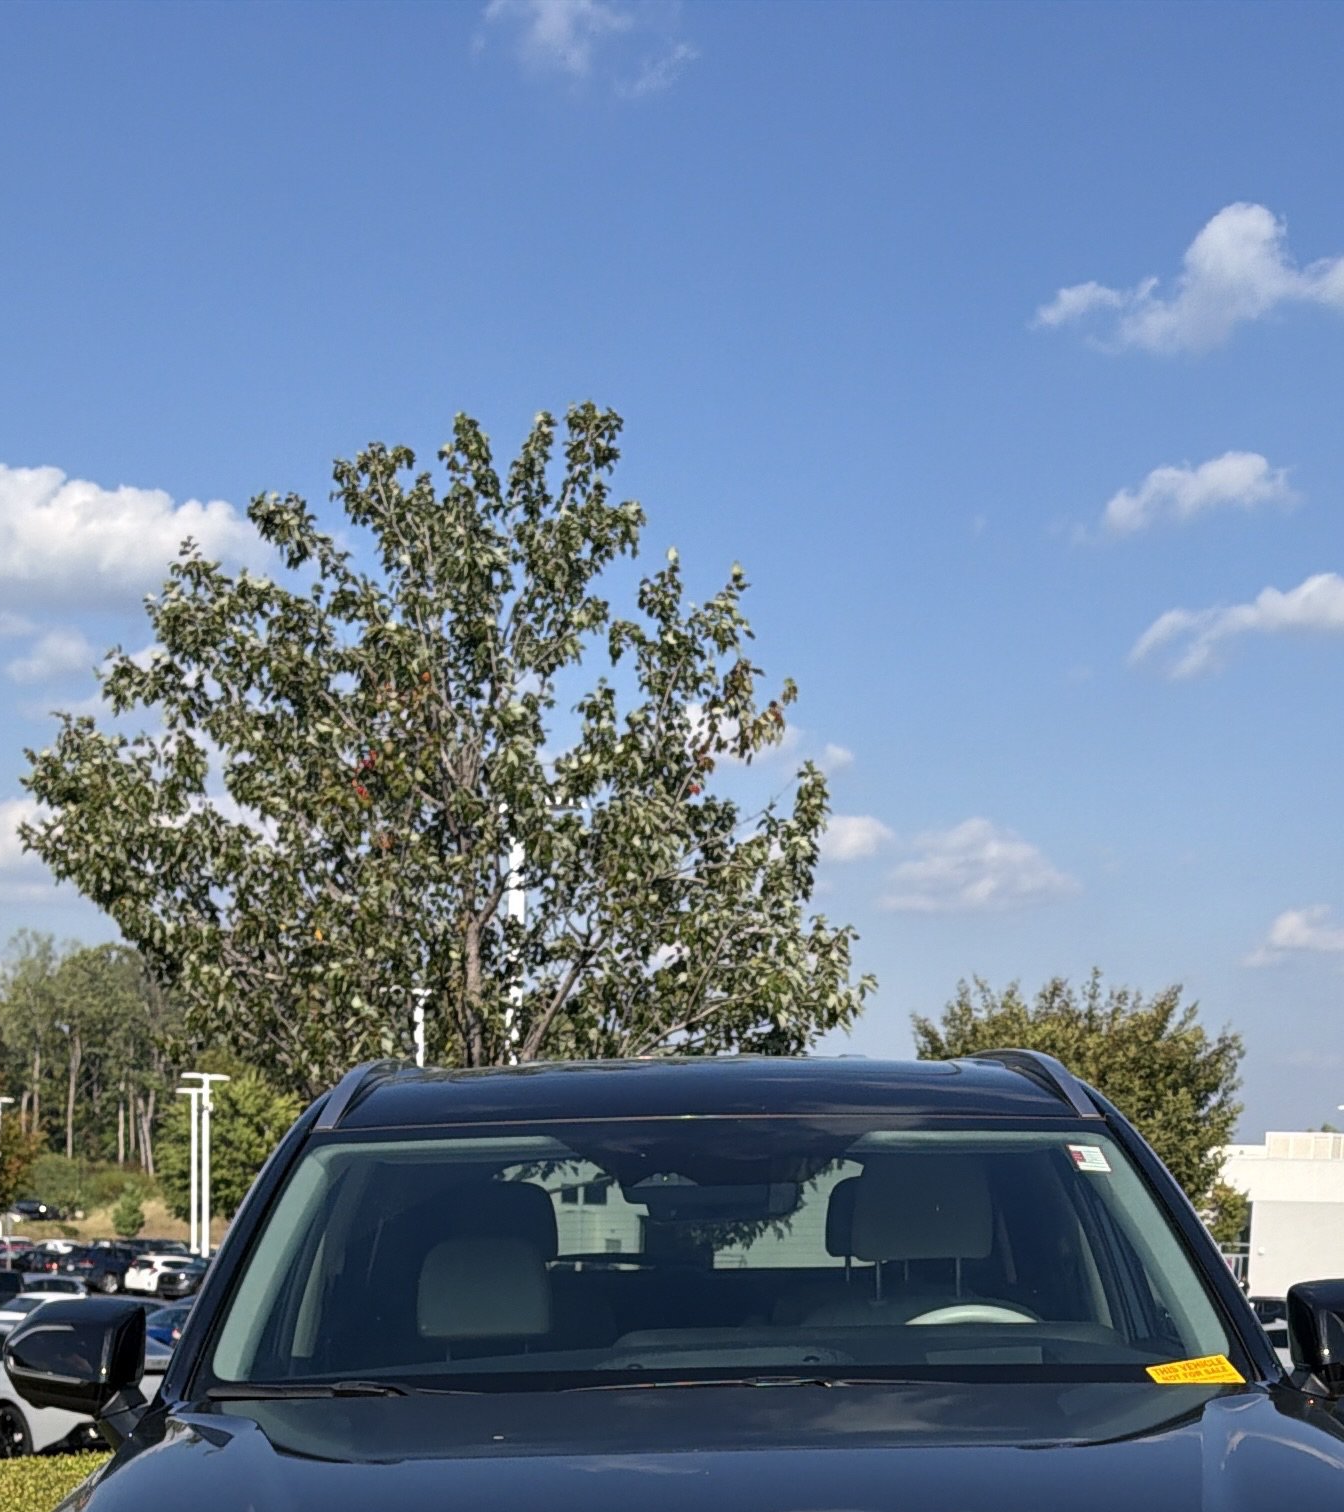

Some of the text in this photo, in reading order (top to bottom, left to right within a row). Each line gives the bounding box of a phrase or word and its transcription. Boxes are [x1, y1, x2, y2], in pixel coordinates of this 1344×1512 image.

[1151, 1357, 1225, 1377] THIS VEHICLE
[1203, 1365, 1229, 1375] SALE
